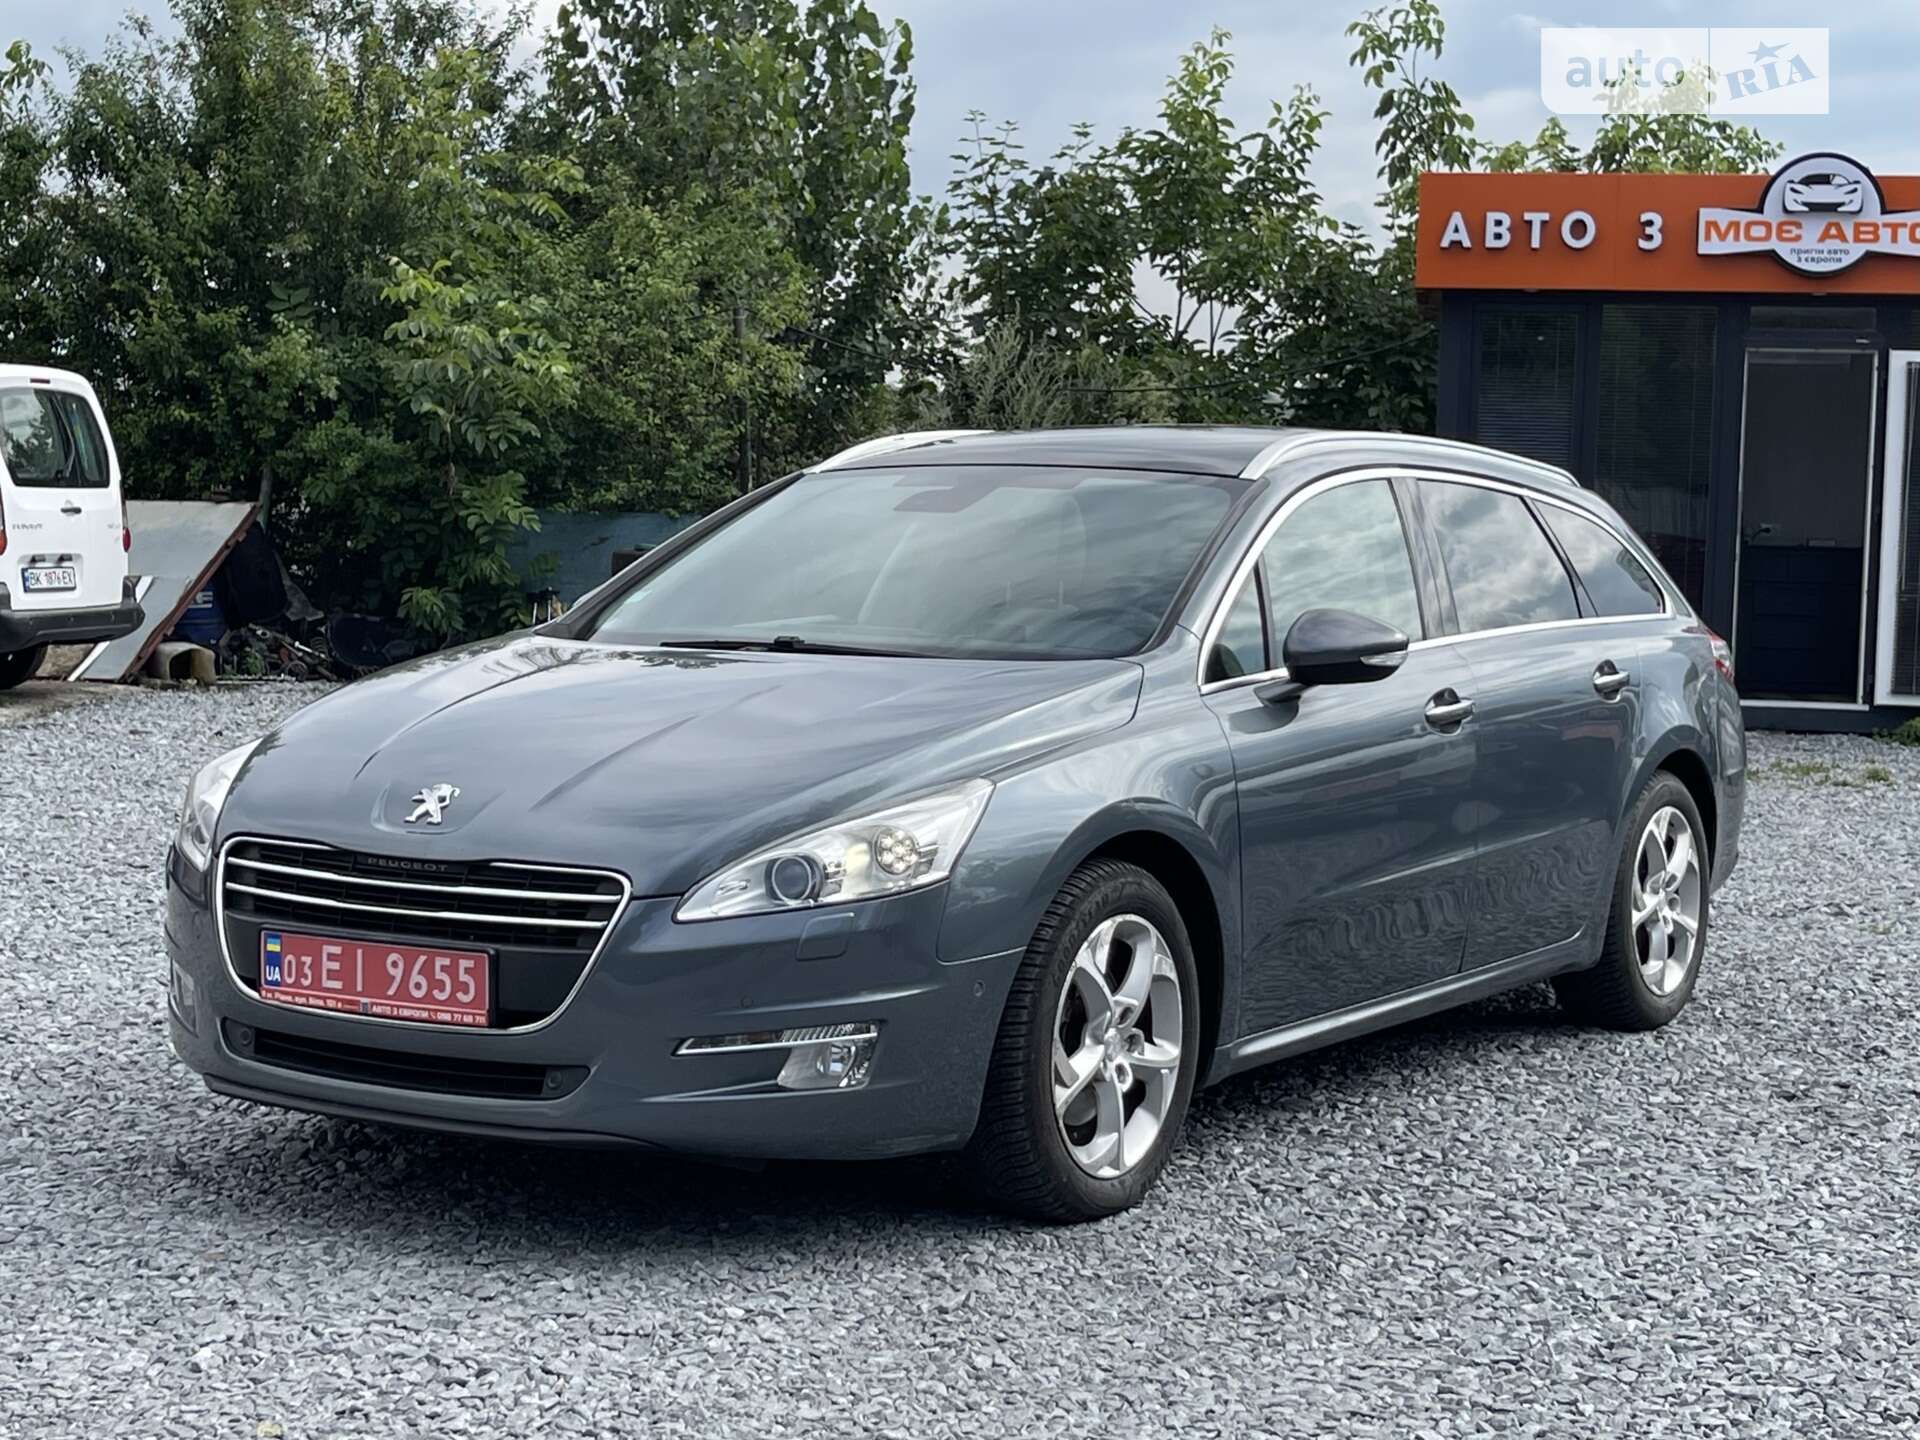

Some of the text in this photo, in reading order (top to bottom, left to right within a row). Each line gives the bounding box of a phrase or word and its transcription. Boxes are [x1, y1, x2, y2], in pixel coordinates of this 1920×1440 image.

[1440, 211, 1597, 249] АВТО
[1704, 220, 1803, 242] МОЄ
[368, 857, 448, 871] PEUGEOT
[266, 966, 281, 982] UA
[284, 954, 313, 986] 03
[322, 945, 363, 992] EI
[385, 953, 476, 1003] 9655
